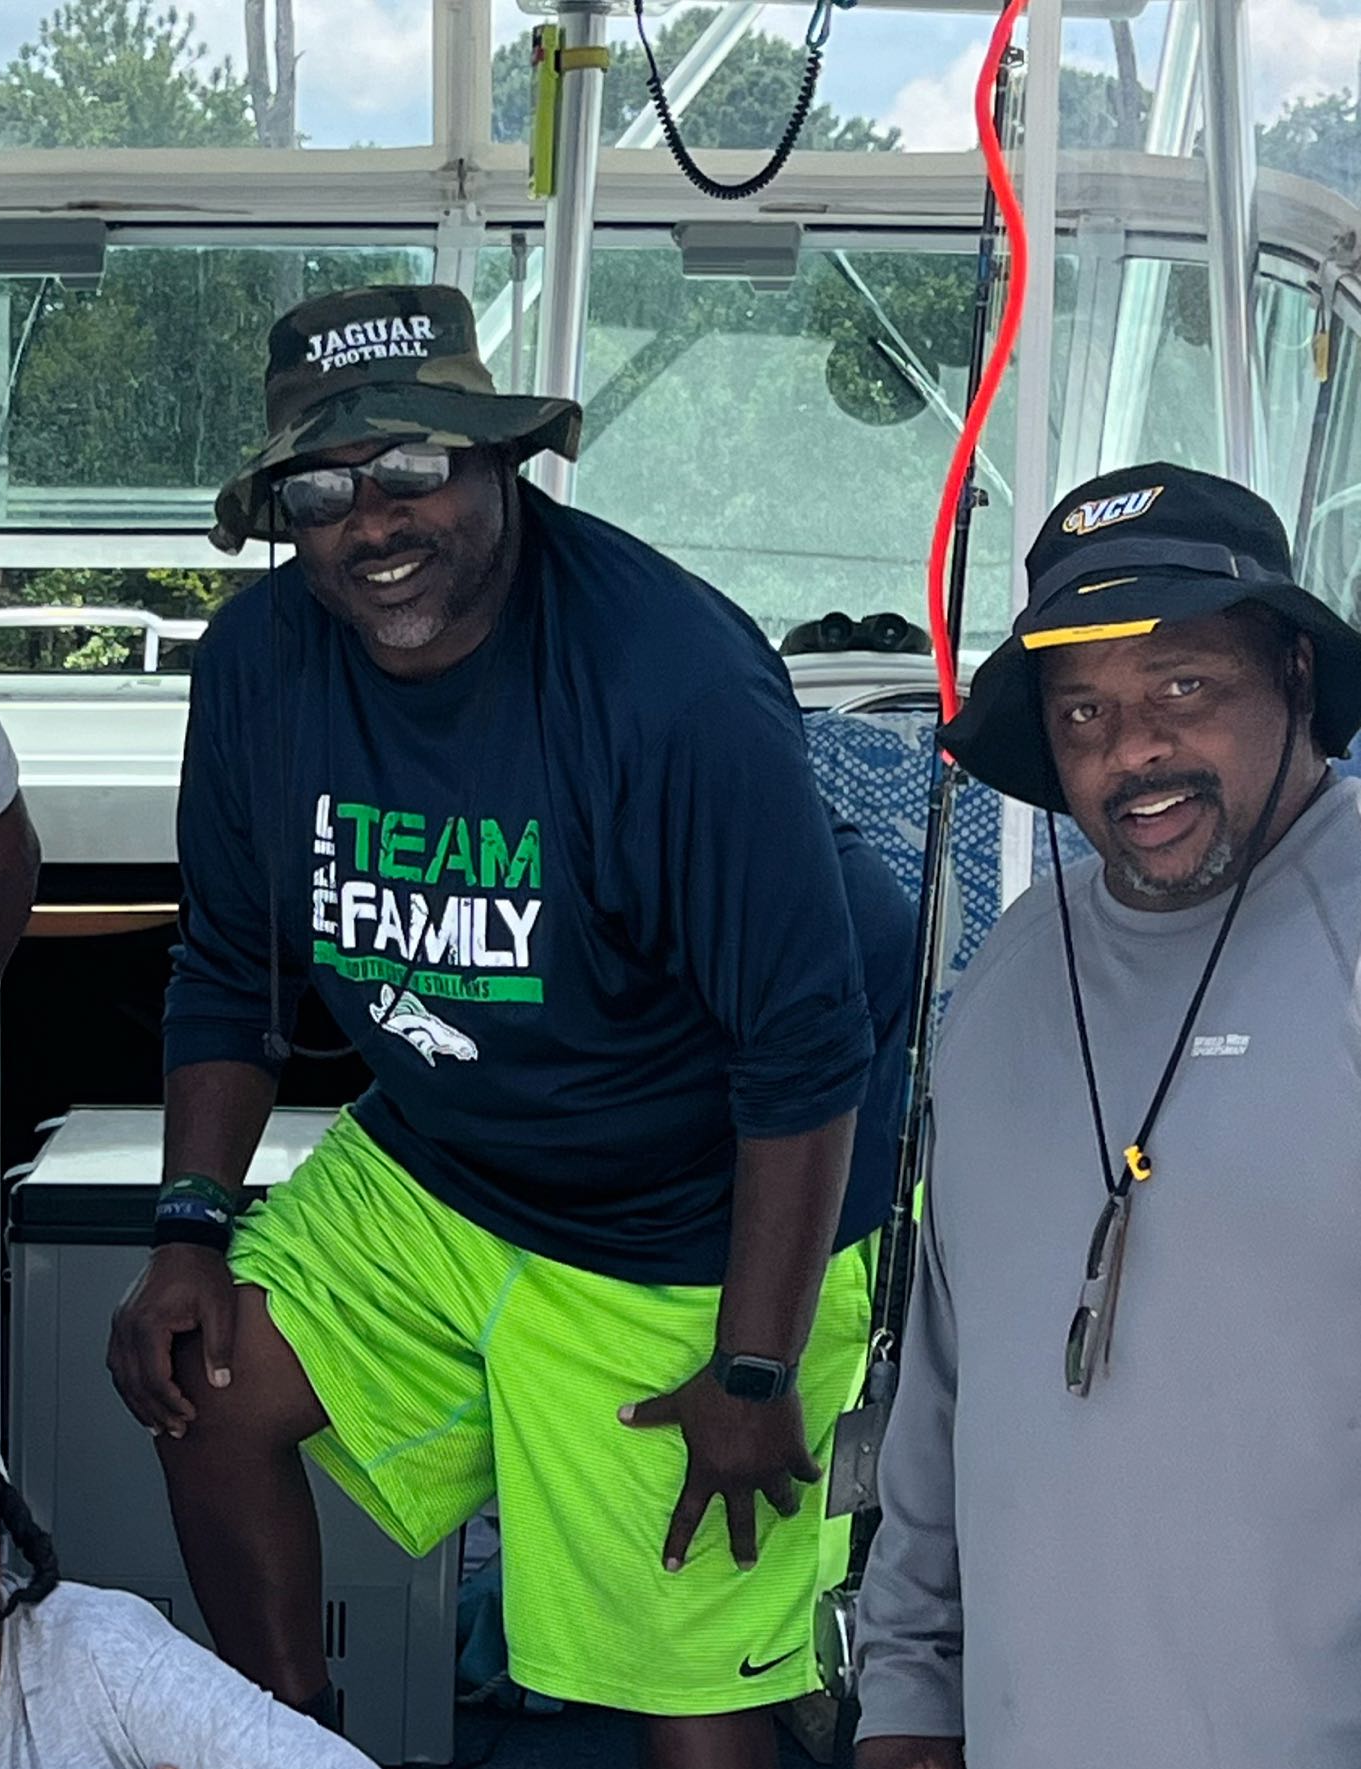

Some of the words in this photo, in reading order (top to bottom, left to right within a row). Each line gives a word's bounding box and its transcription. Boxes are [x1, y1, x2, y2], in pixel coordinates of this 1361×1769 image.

[306, 315, 435, 363] JAGUAR
[320, 342, 428, 373] FOOTBALL
[1077, 488, 1155, 528] VCU
[337, 803, 540, 888] TEAM
[341, 881, 542, 968] FAMILY
